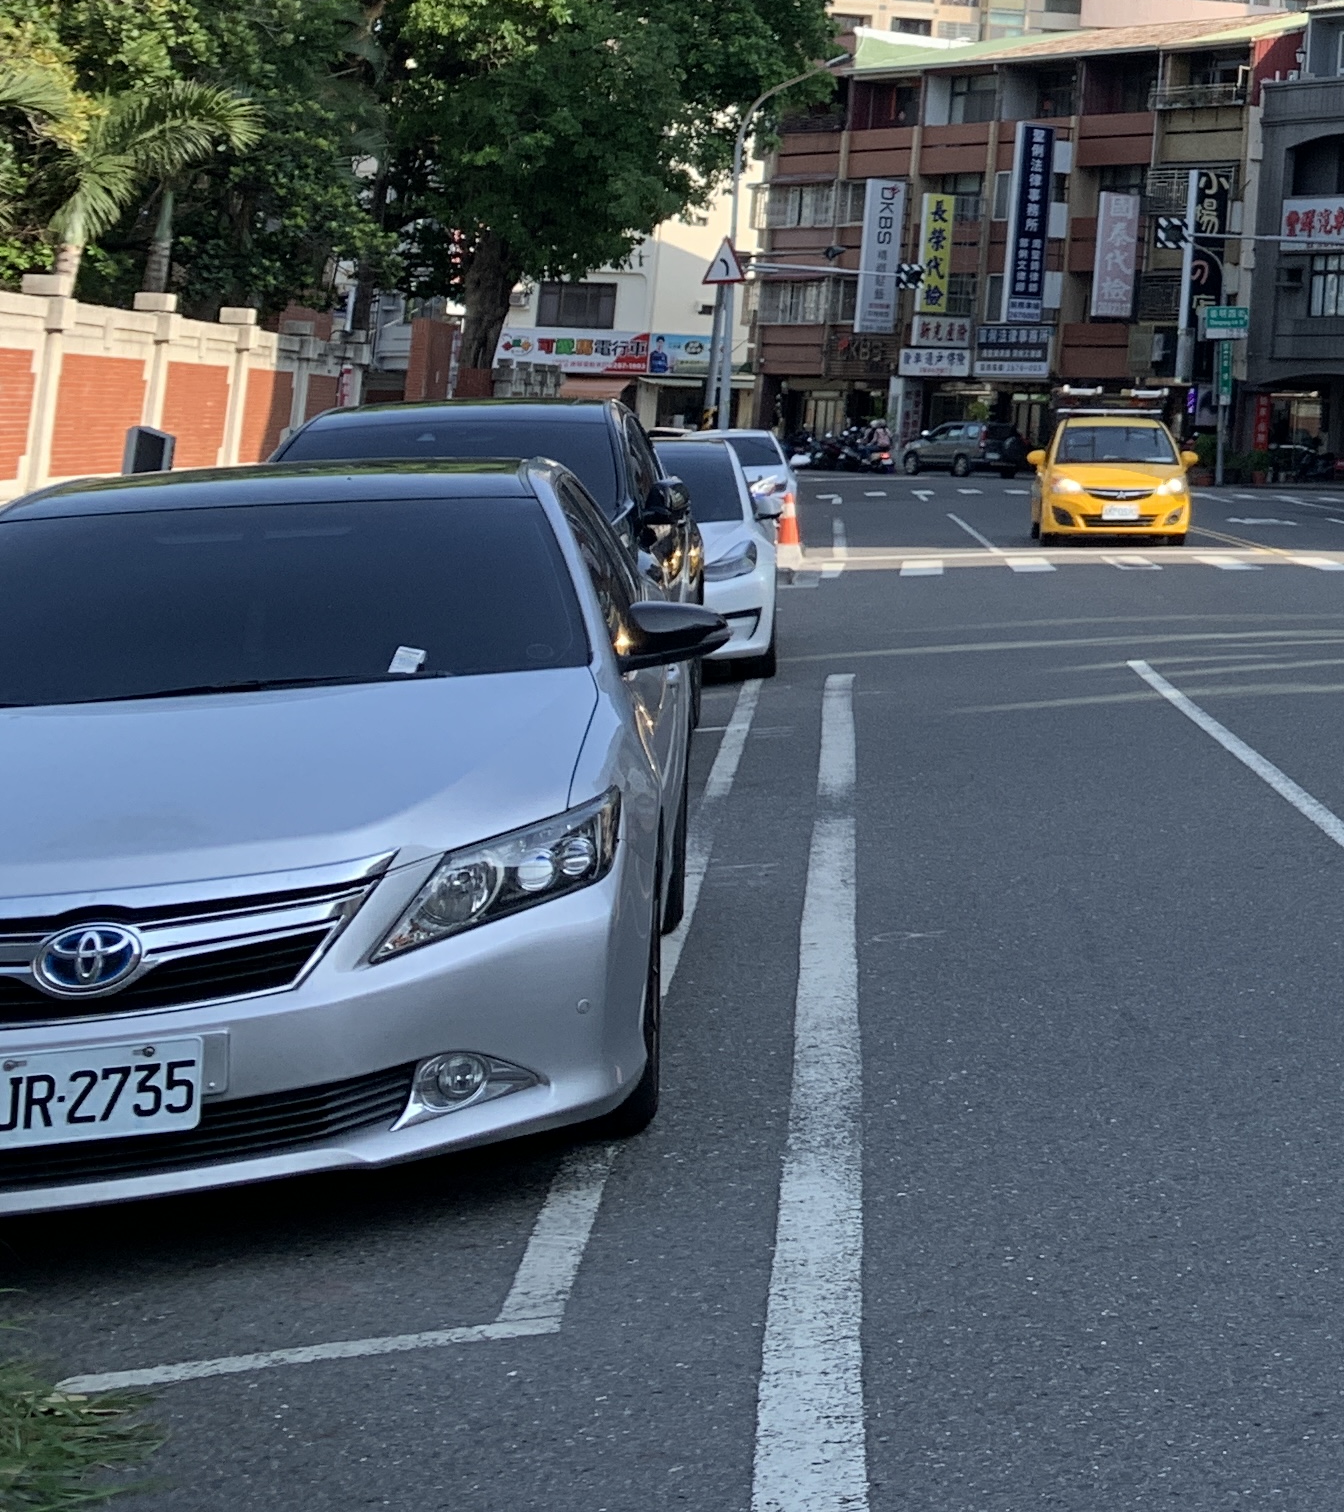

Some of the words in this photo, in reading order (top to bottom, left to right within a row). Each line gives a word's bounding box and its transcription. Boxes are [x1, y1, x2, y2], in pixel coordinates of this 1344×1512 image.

[924, 199, 949, 307] 長榮代檢
[1100, 195, 1134, 301] 國泰代檢
